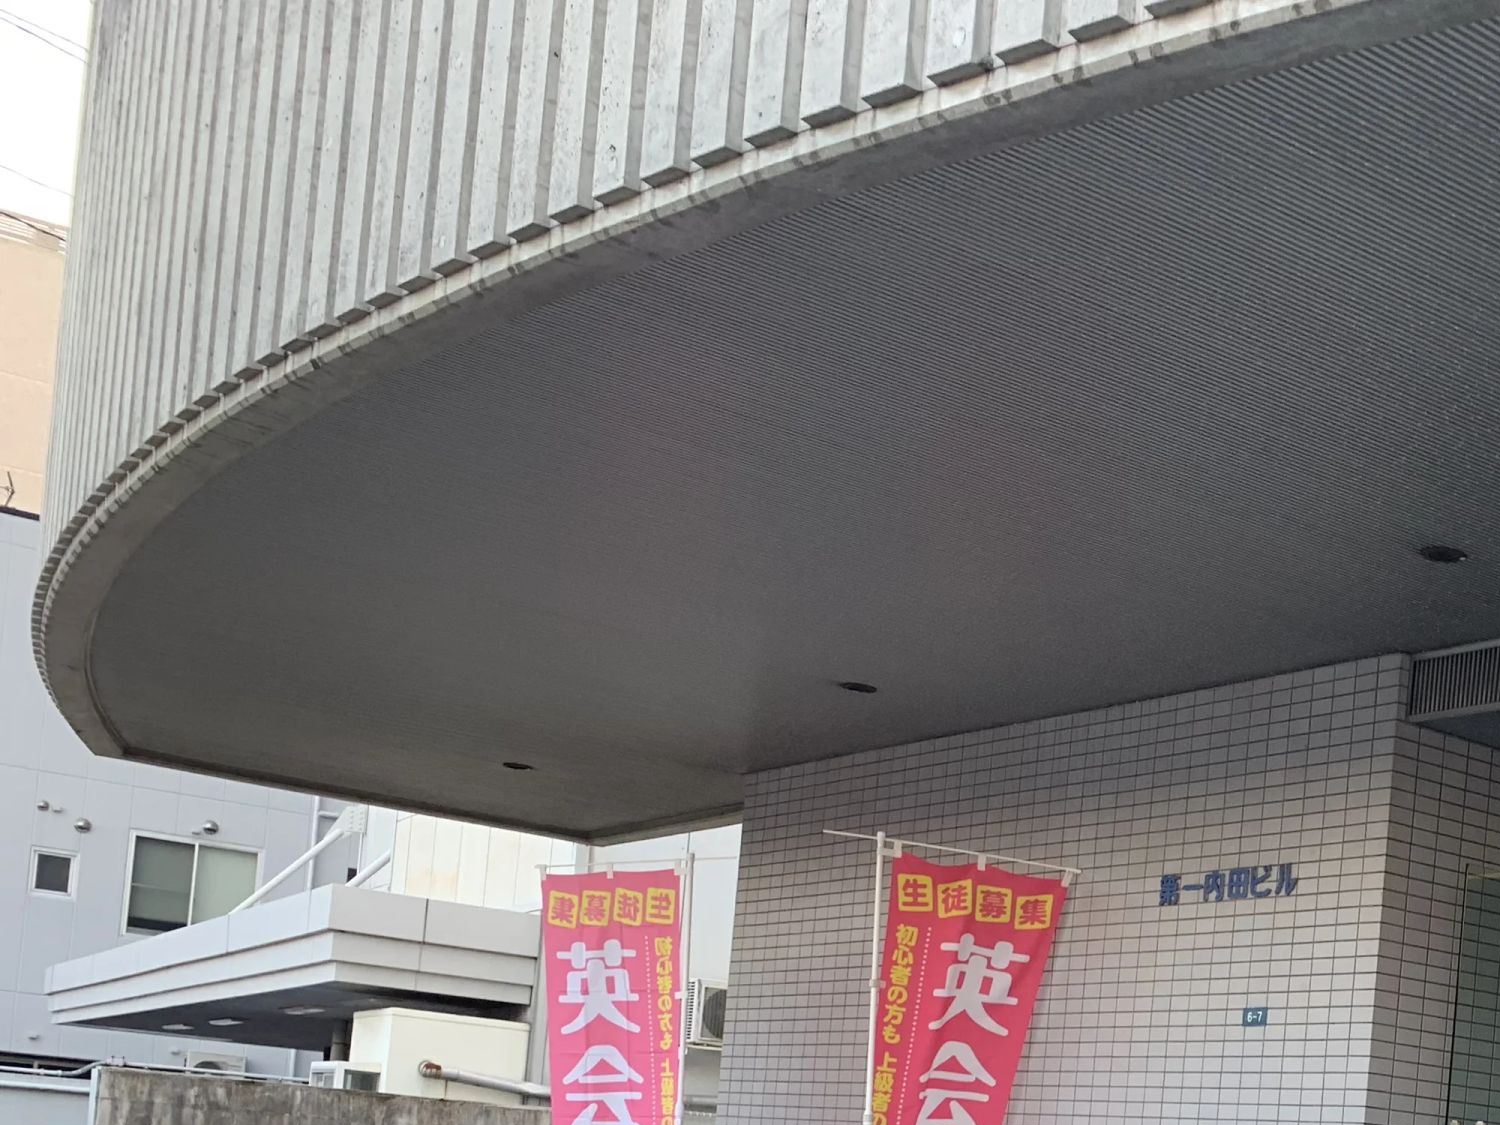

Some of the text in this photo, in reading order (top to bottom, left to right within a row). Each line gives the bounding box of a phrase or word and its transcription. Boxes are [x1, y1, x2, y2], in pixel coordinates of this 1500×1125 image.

[902, 878, 1048, 926] 生徒募集
[1159, 863, 1298, 906] 第一内田ビル
[882, 923, 919, 1044] 初心者の方も
[1247, 1011, 1263, 1022] 6-7
